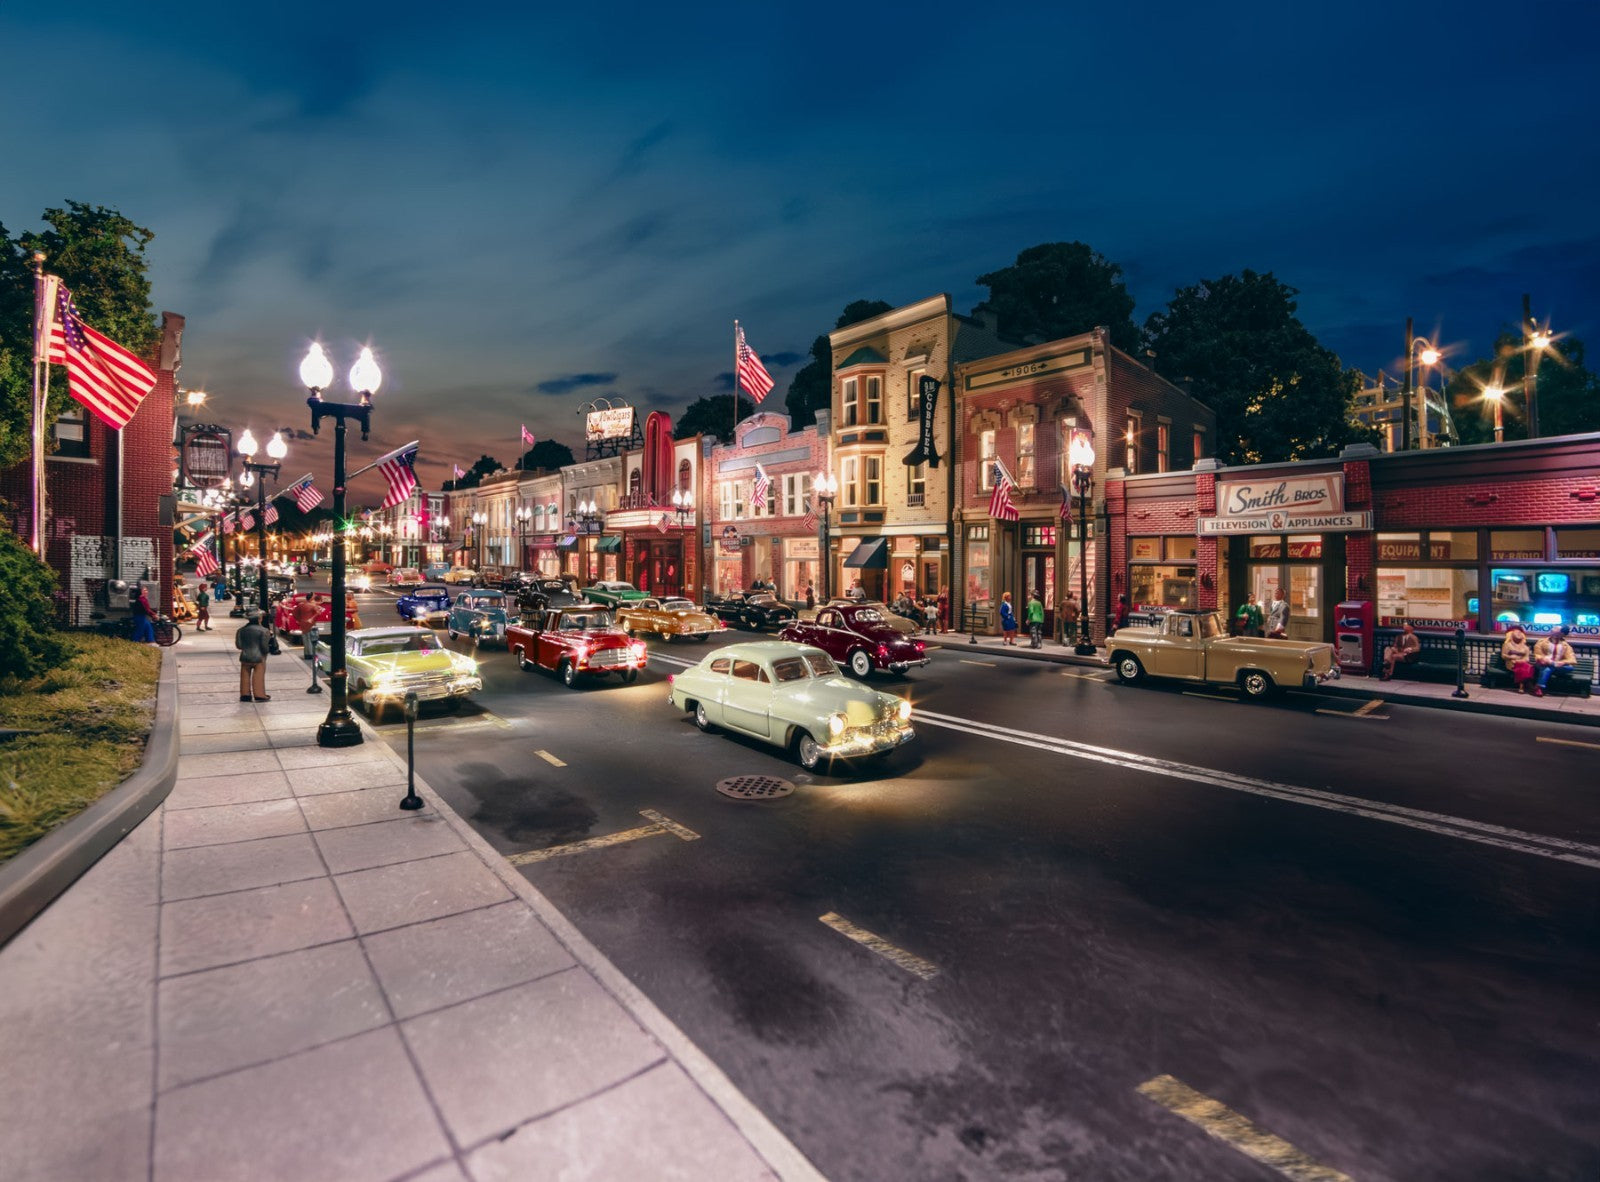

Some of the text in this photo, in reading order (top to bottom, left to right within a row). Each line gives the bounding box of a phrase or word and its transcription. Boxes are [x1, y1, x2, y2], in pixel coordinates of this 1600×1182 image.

[1011, 364, 1037, 377] 1906
[923, 393, 934, 456] COBBLER
[1229, 482, 1327, 514] Smith BROS.
[1210, 513, 1353, 530] TELEVISION & APPLIANCES
